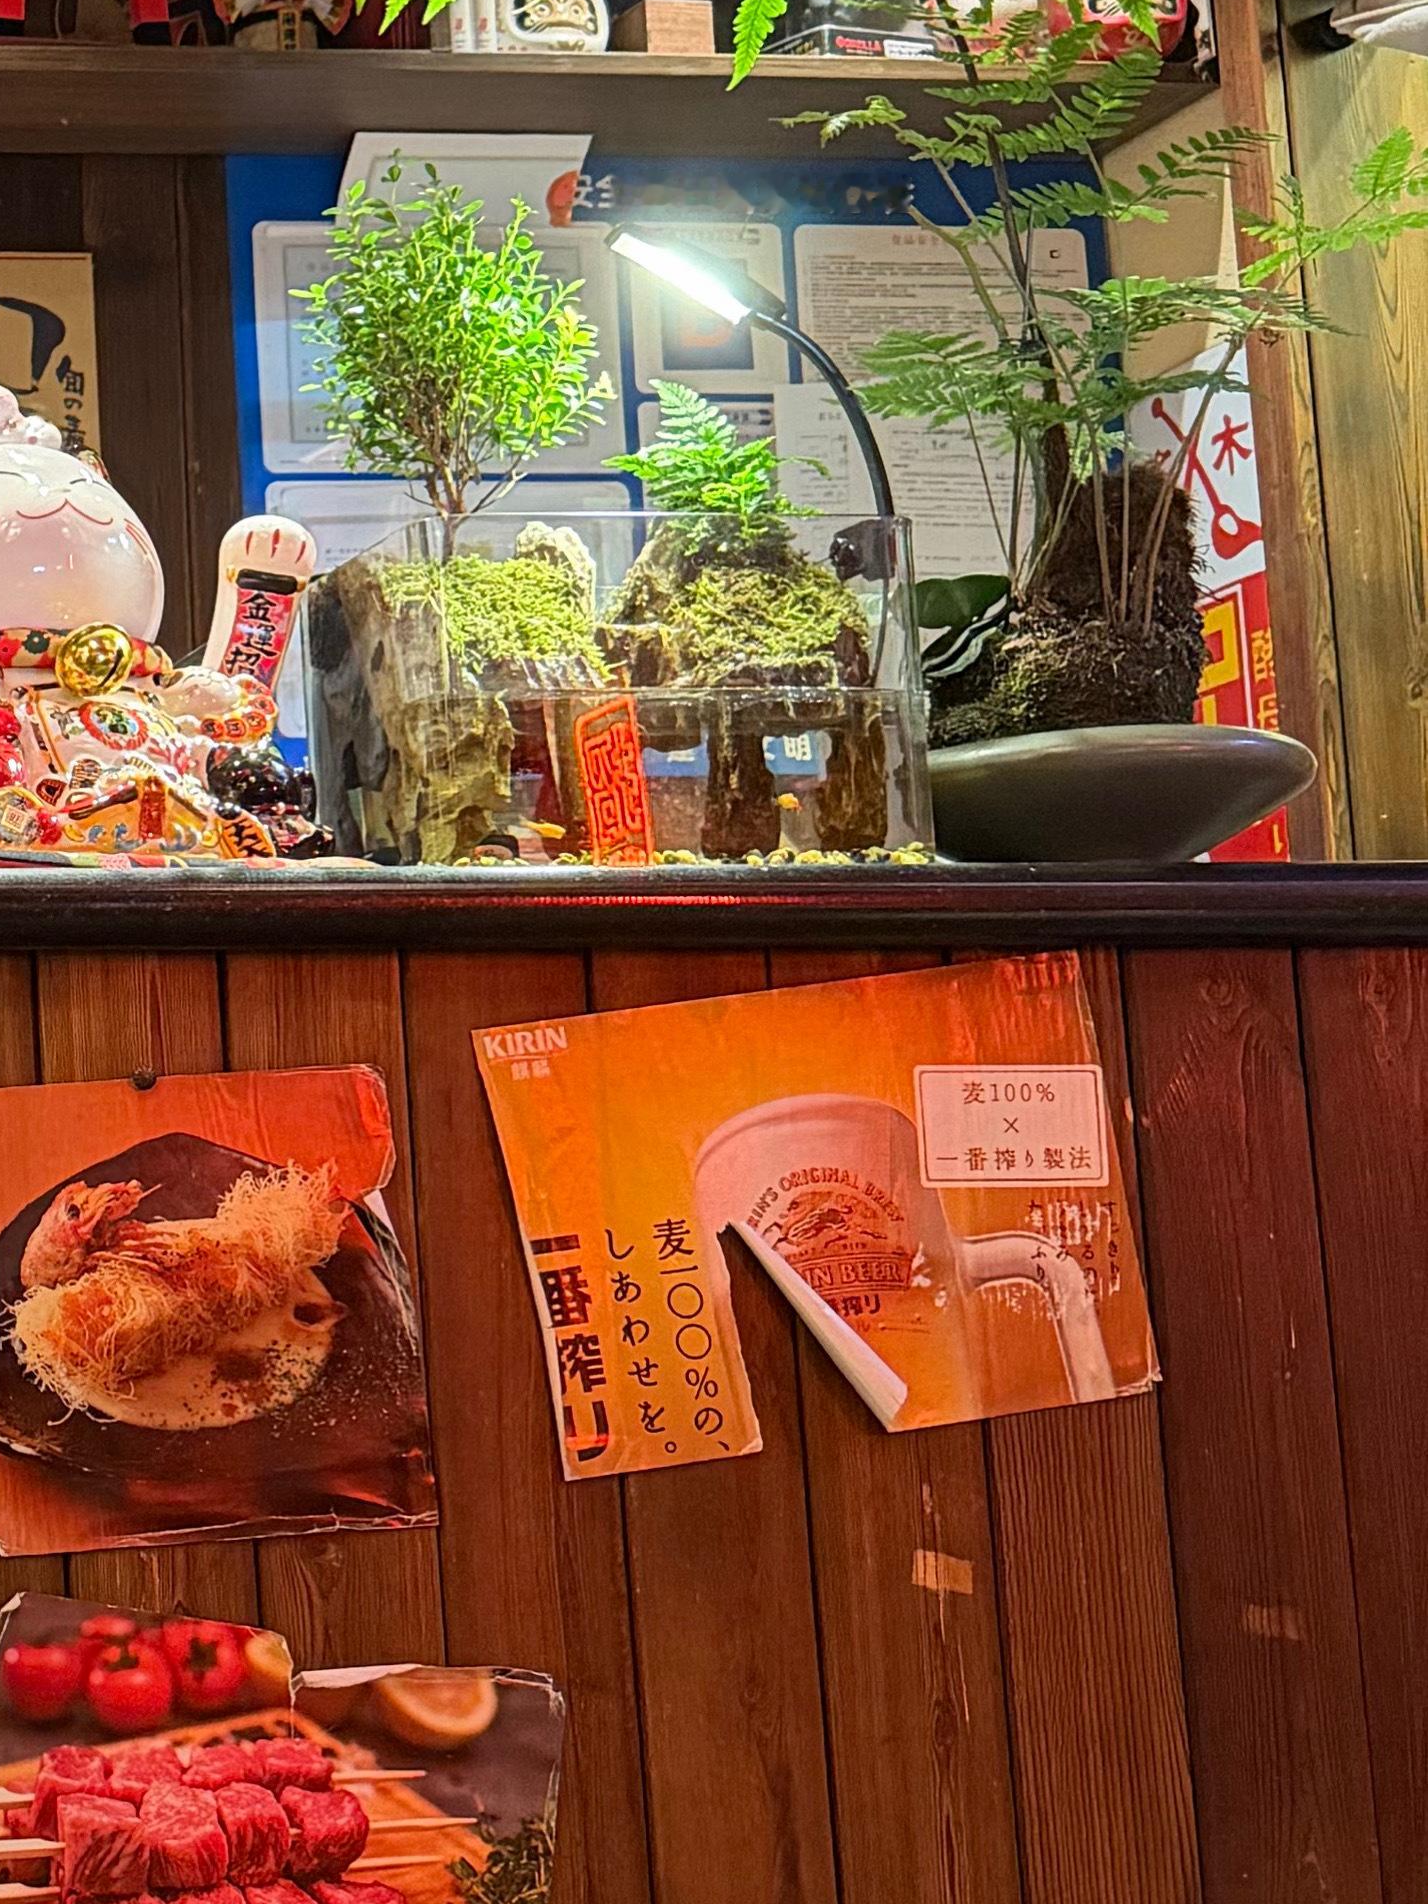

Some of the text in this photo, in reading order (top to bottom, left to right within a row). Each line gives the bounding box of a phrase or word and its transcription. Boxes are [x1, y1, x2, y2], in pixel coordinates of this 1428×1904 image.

[482, 1024, 568, 1059] KIRIN
[960, 1080, 1056, 1105] 麦100%
[935, 1145, 1093, 1172] 一番搾り製法
[778, 1166, 860, 1193] ORIGINAL
[840, 1260, 905, 1286] BEER
[529, 1233, 611, 1463] 一番搾り
[604, 1228, 678, 1455] しあわせを。
